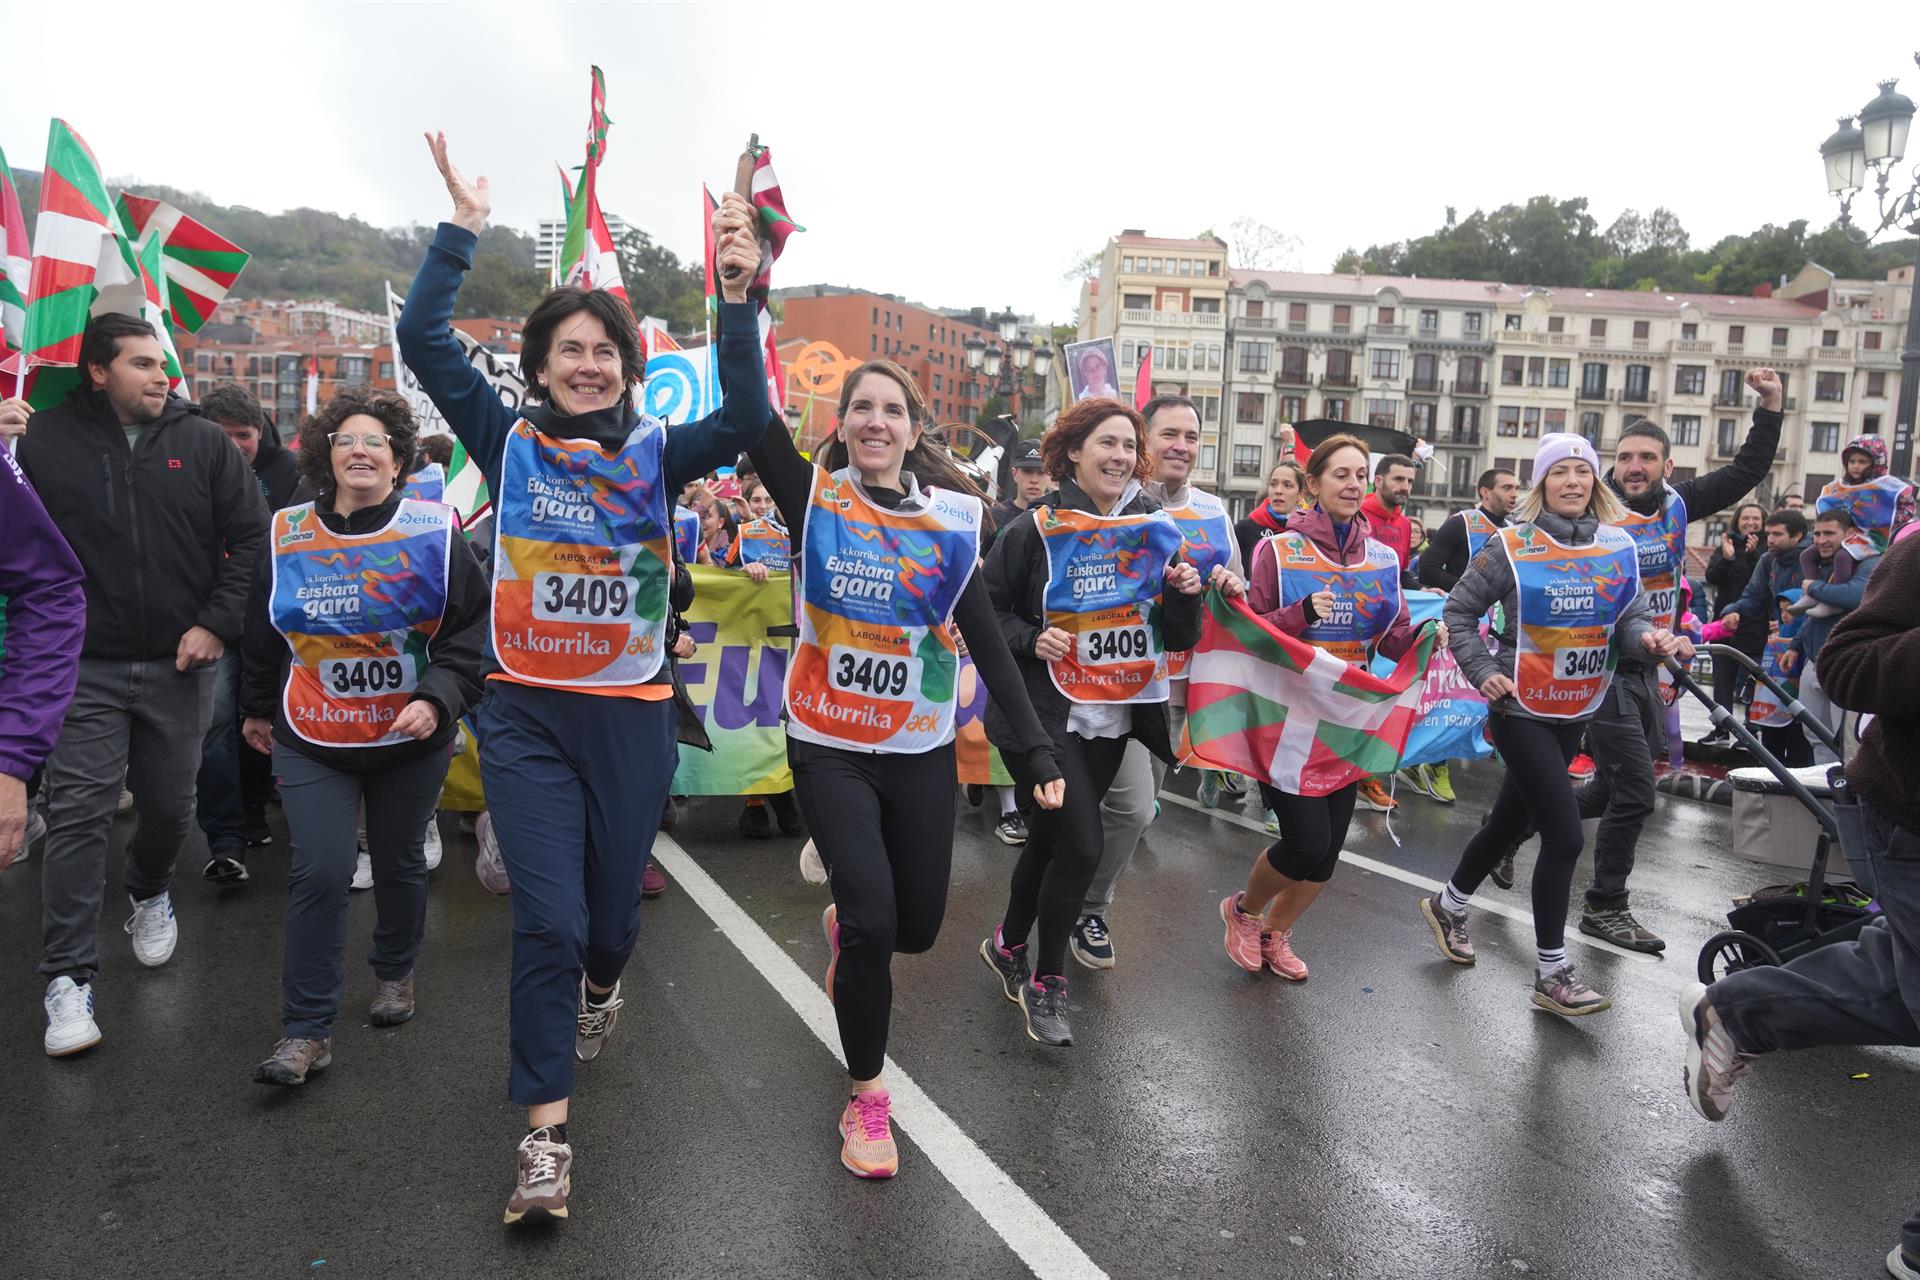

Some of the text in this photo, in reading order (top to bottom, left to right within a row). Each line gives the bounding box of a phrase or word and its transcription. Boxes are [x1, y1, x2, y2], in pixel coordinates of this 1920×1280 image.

[413, 514, 443, 525] eitb
[531, 496, 596, 522] gara
[949, 507, 975, 525] eitb
[554, 552, 599, 565] LABORAL
[825, 555, 895, 582] Euskara
[1066, 562, 1116, 578] Euskara
[296, 583, 359, 600] Euskara
[544, 575, 629, 617] 3409
[829, 574, 894, 601] gara
[1073, 575, 1116, 599] gara
[1544, 585, 1594, 596] Euskara
[302, 596, 360, 620] gara
[1092, 612, 1125, 622] LABORAL
[1550, 596, 1594, 615] gara
[503, 627, 610, 656] 24.korrika
[851, 629, 892, 644] LABORAL
[1088, 629, 1148, 661] 3409
[1565, 648, 1606, 677] 3409
[332, 659, 403, 693] 3409
[836, 653, 908, 697] 3409
[295, 702, 395, 723] 24.korrika
[791, 690, 941, 733] 24.korrika aek
